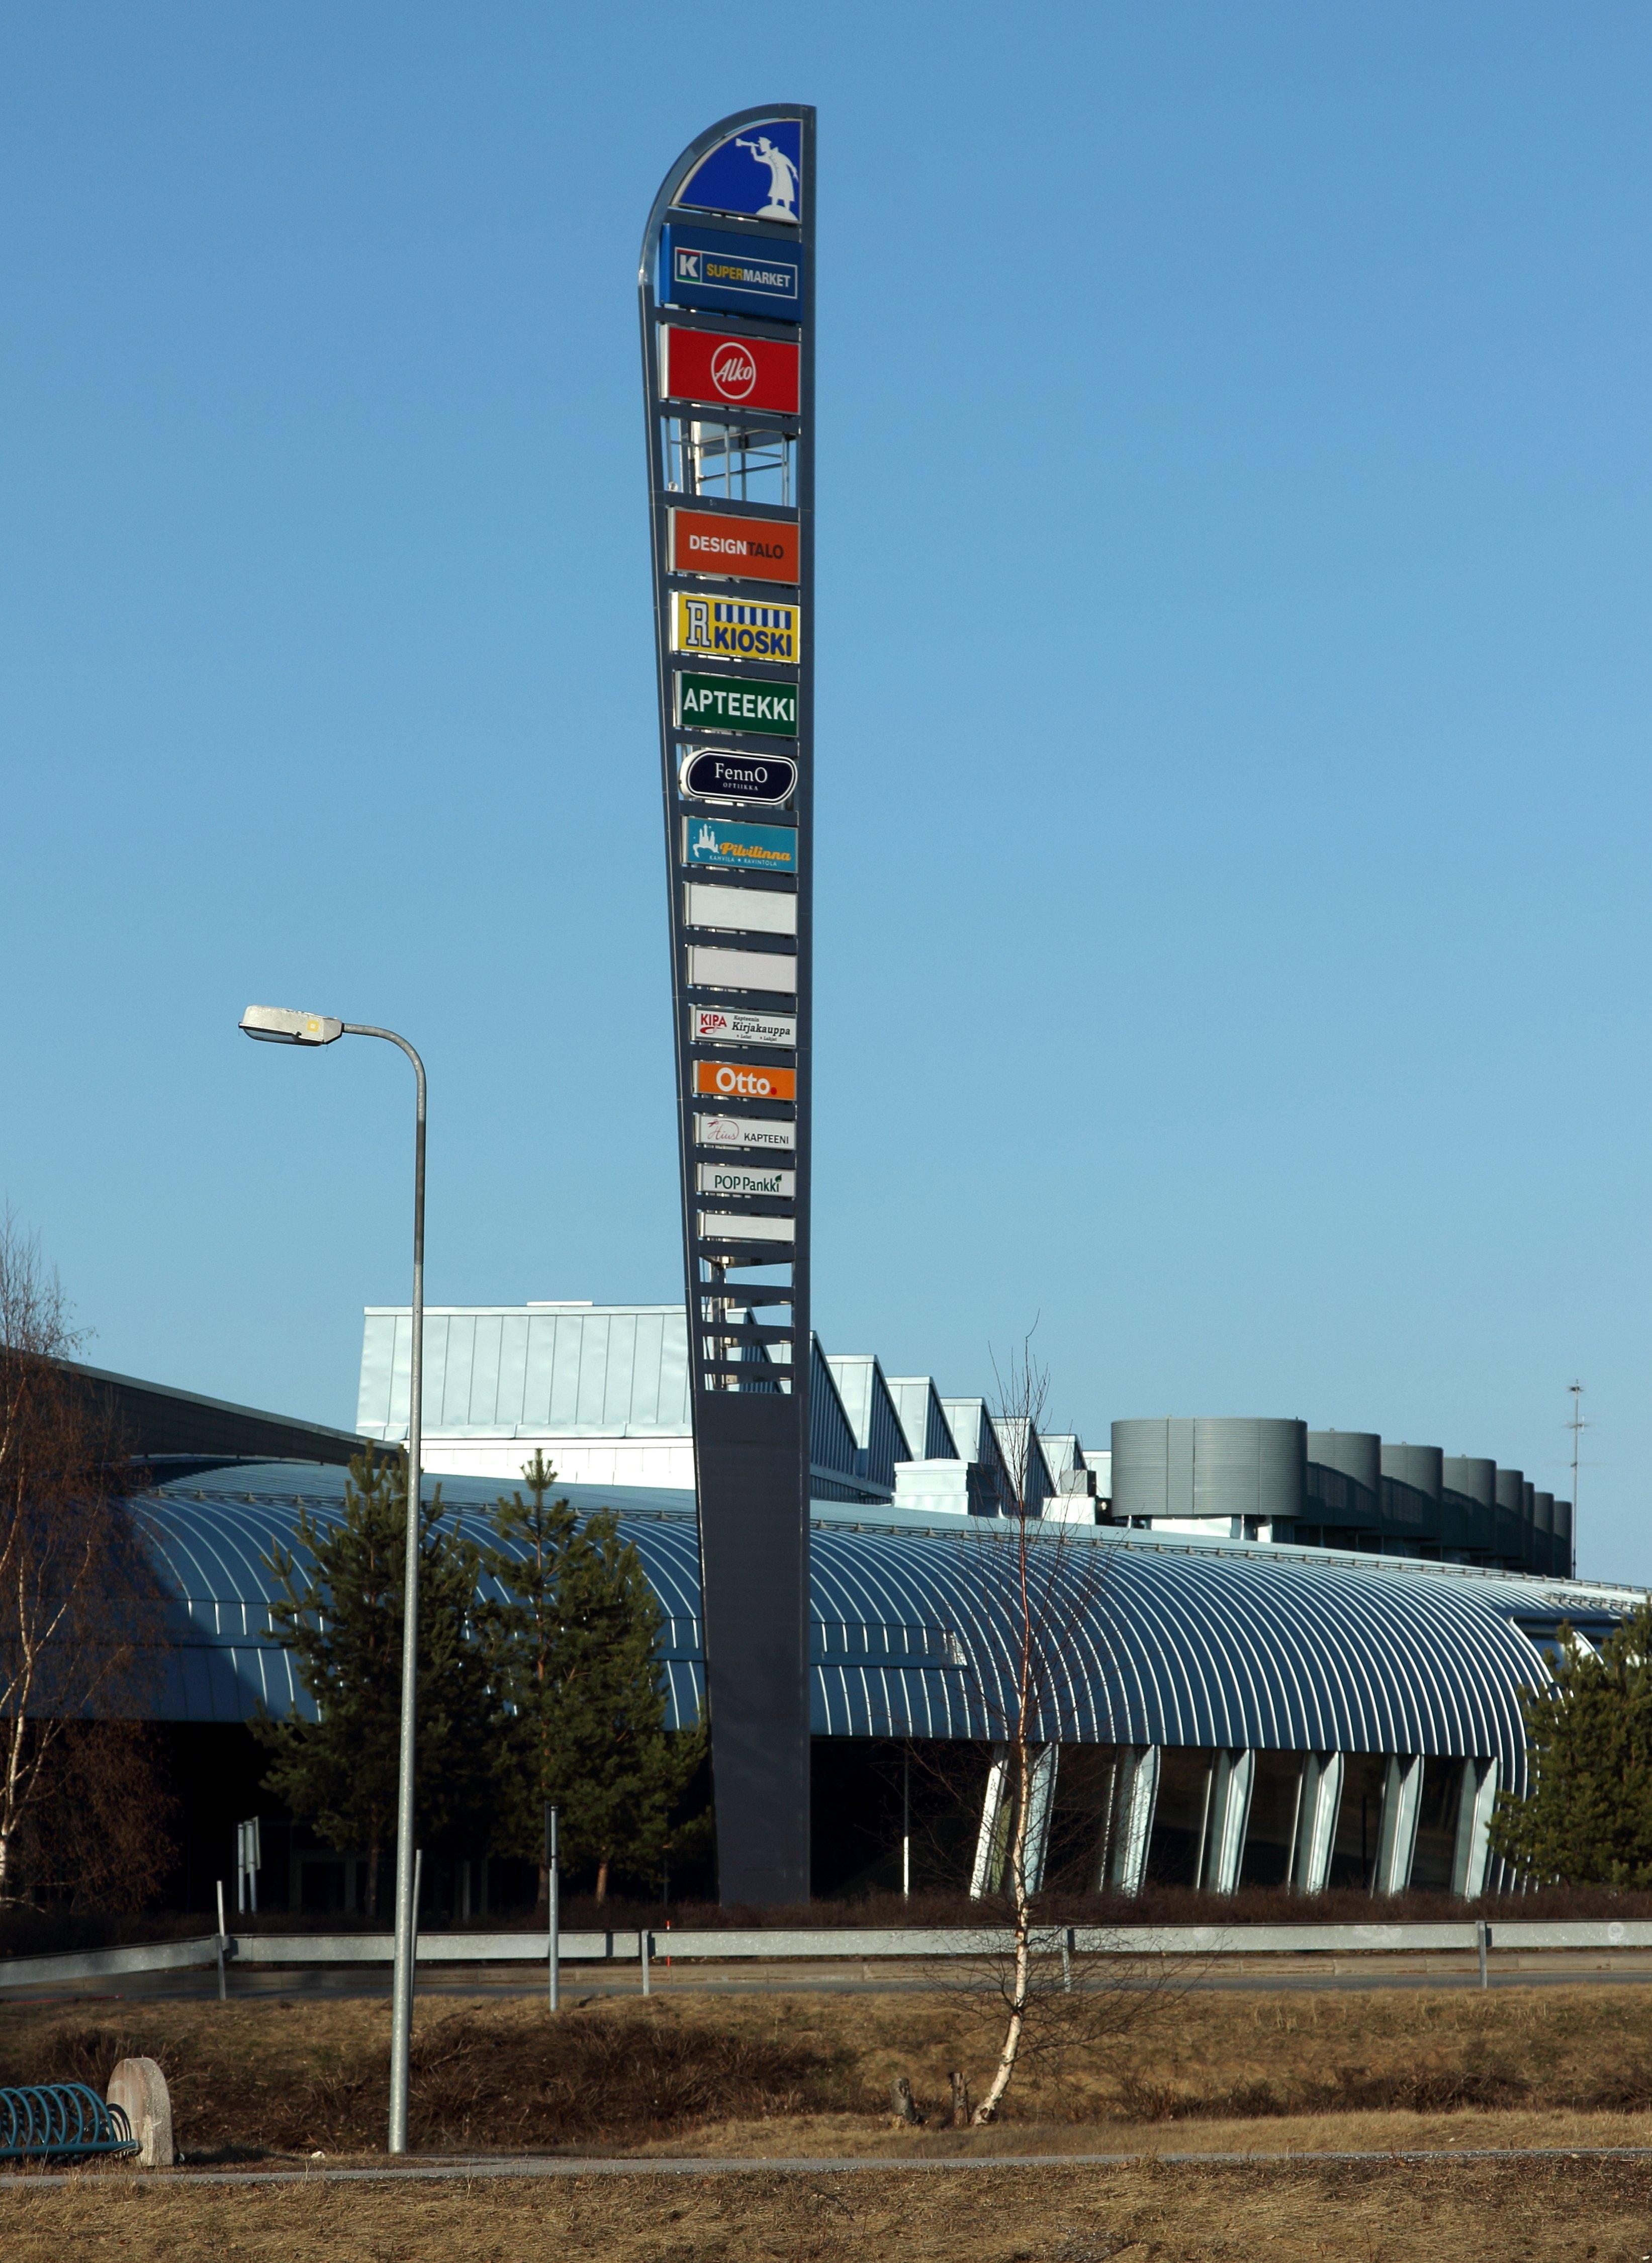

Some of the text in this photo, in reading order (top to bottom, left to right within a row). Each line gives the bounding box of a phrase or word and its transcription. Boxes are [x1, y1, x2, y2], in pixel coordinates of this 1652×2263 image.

[679, 254, 791, 288] K SUPERMARKET
[715, 358, 753, 382] Alko
[689, 534, 784, 560] DESIGNTALO
[686, 599, 711, 648] R
[714, 626, 792, 657] KIOSKI
[683, 688, 795, 721] APTEEKKI
[715, 762, 768, 783] FennO
[722, 781, 759, 791] OPTIIKKA
[709, 855, 777, 866] KAHVILA RAVINTOLA
[719, 842, 791, 861] Pilvilinna
[700, 1013, 727, 1027] KIPA
[731, 1021, 791, 1037] Kirjakauppa
[744, 1133, 789, 1144] KAPTEENI
[714, 1175, 779, 1192] POP Pankki
